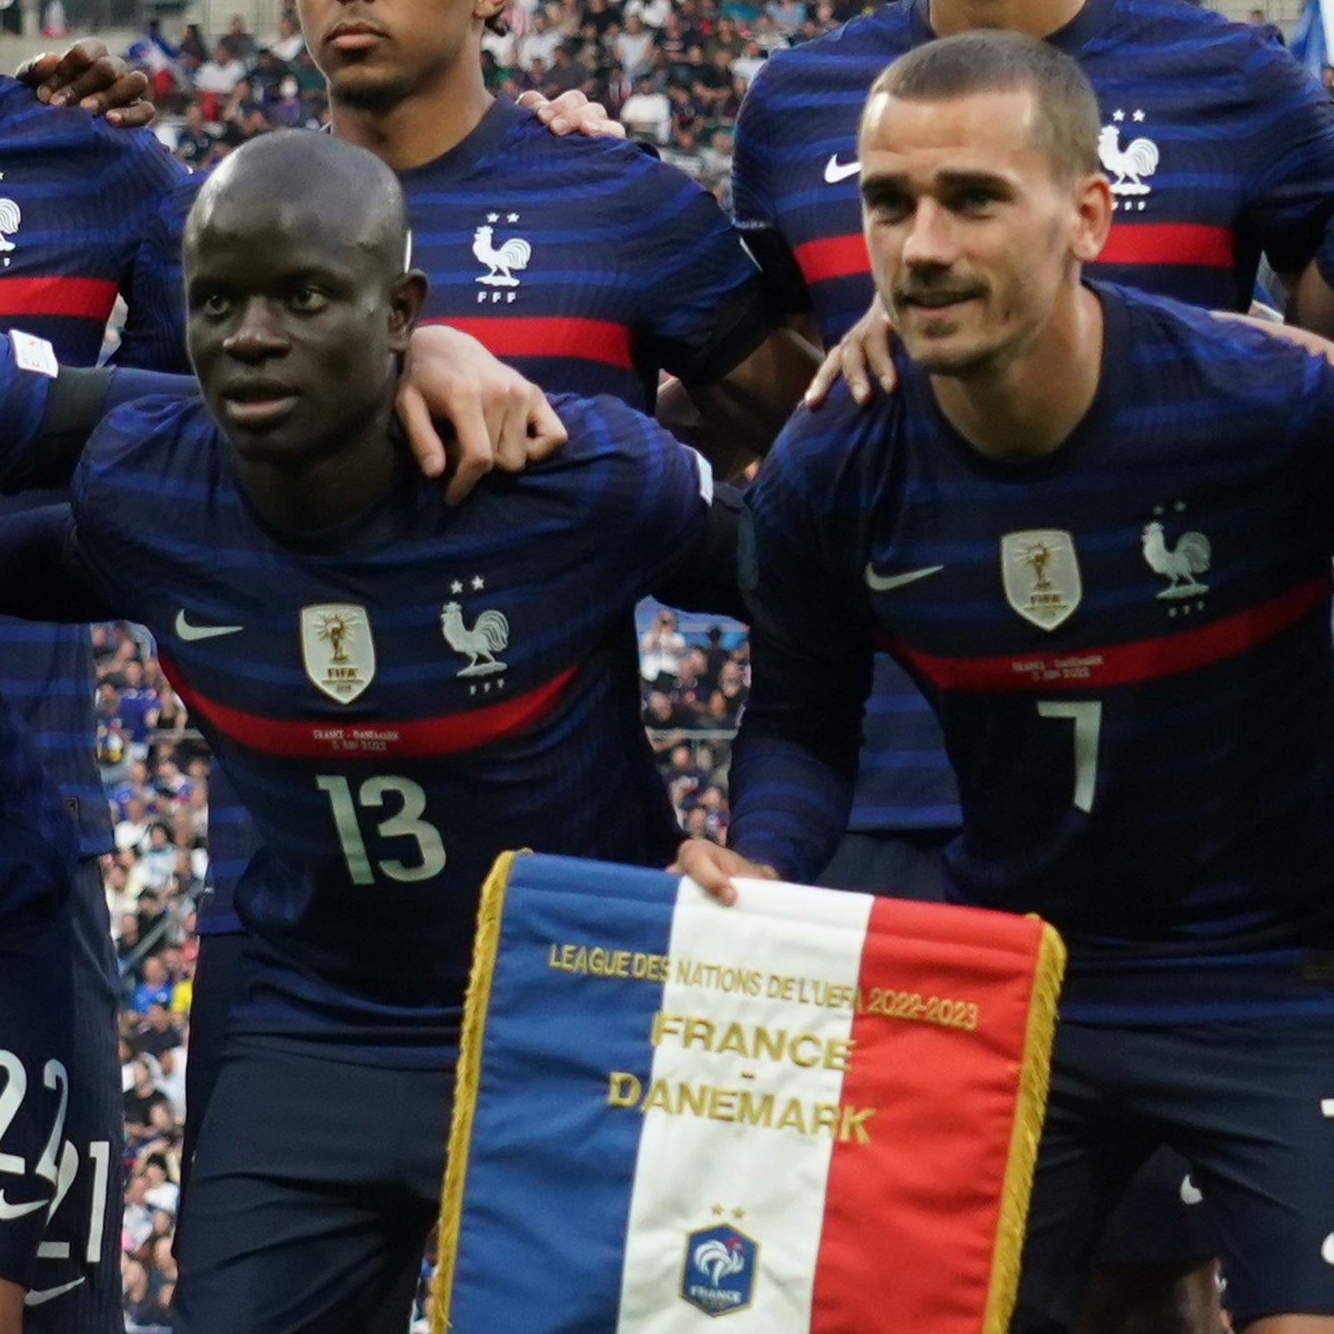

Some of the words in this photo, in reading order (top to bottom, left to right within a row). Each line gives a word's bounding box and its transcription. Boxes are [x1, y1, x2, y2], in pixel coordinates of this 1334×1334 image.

[327, 668, 356, 679] FIFA
[1036, 700, 1102, 813] 7
[315, 774, 448, 886] 13
[548, 943, 631, 977] LEAGUE
[632, 953, 670, 983] DES
[675, 958, 762, 997] NATIONS
[766, 975, 797, 1001] DE
[867, 986, 979, 1032] 2022-2023
[649, 1012, 857, 1072] FRANCE
[607, 1071, 877, 1145] DANEMARK
[689, 1283, 743, 1304] FRANCE
